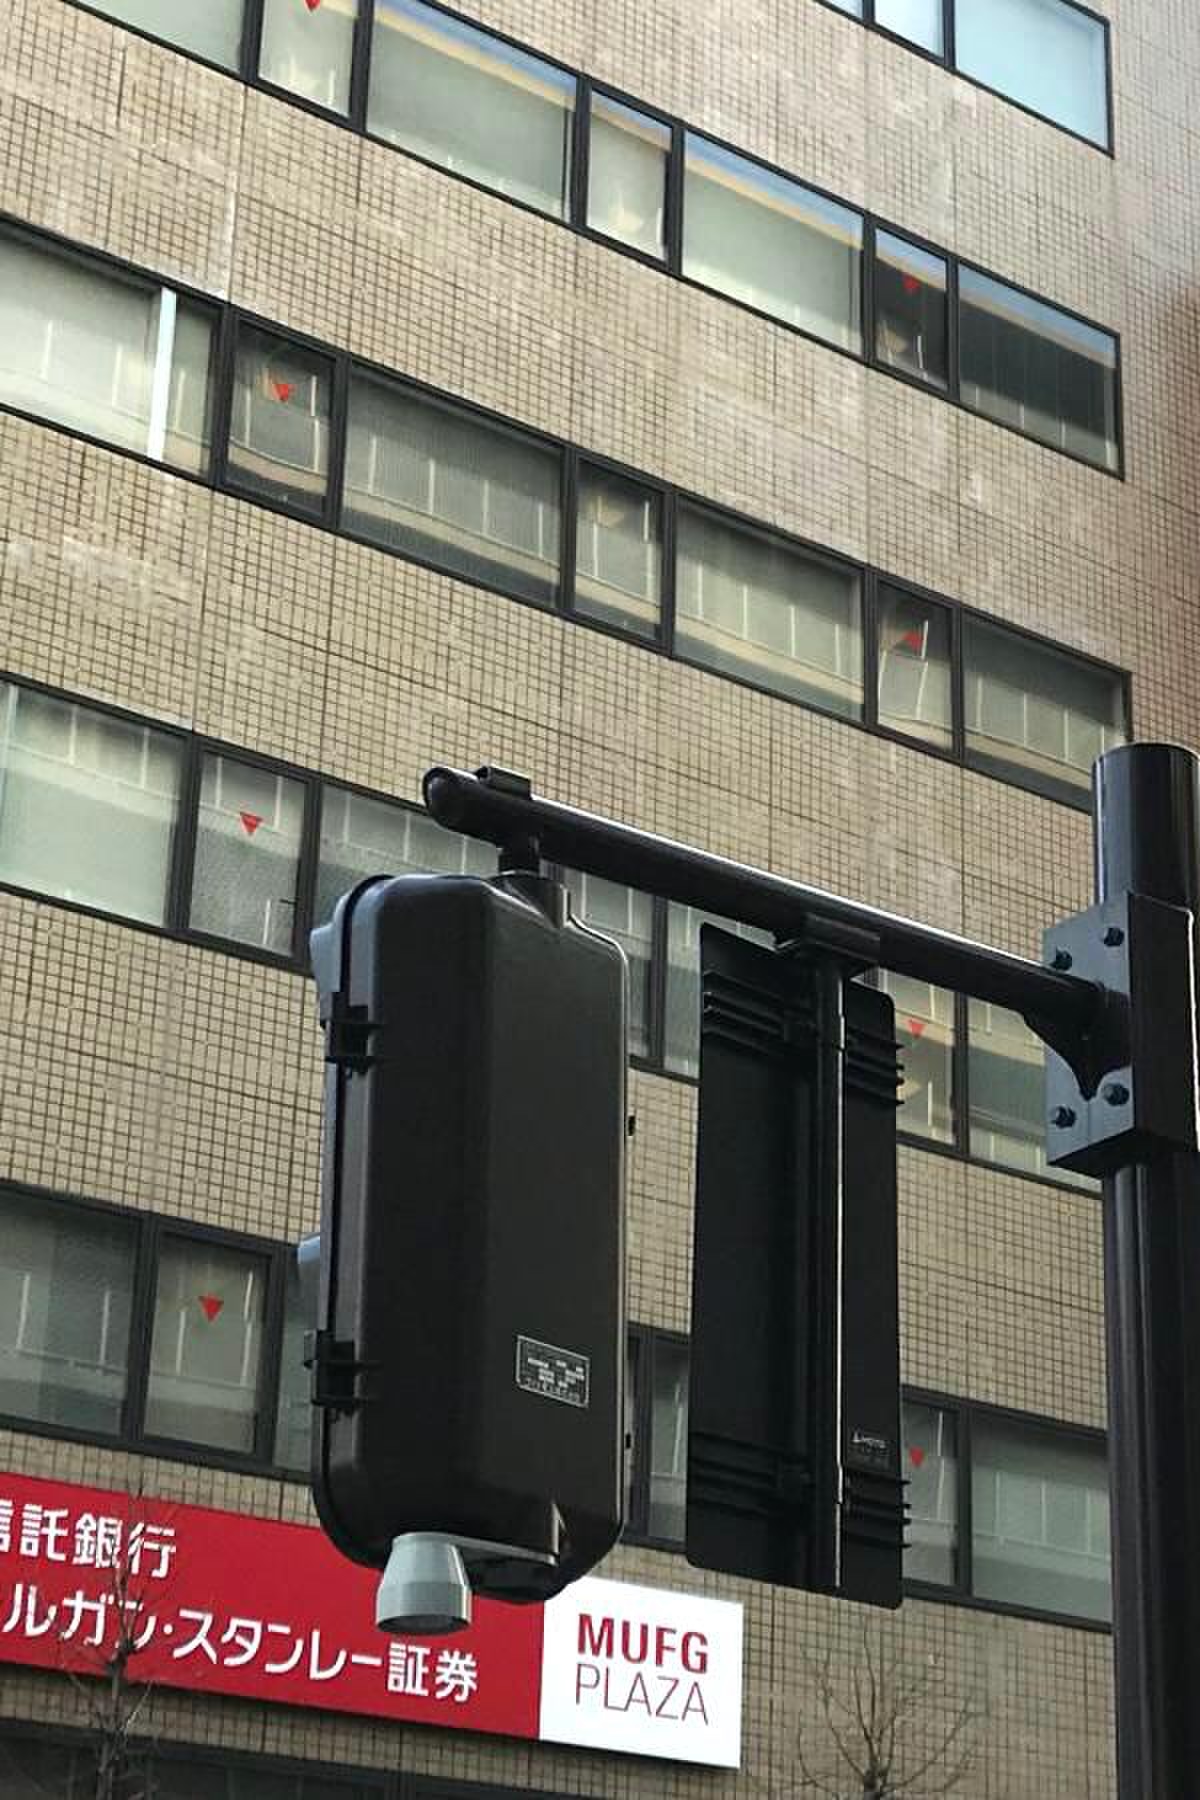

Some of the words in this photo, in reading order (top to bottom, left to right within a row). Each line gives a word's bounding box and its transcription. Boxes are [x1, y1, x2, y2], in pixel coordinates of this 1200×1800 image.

[0, 1499, 177, 1578] 託銀行
[577, 1613, 708, 1675] MUFG
[575, 1662, 708, 1726] PLAZA
